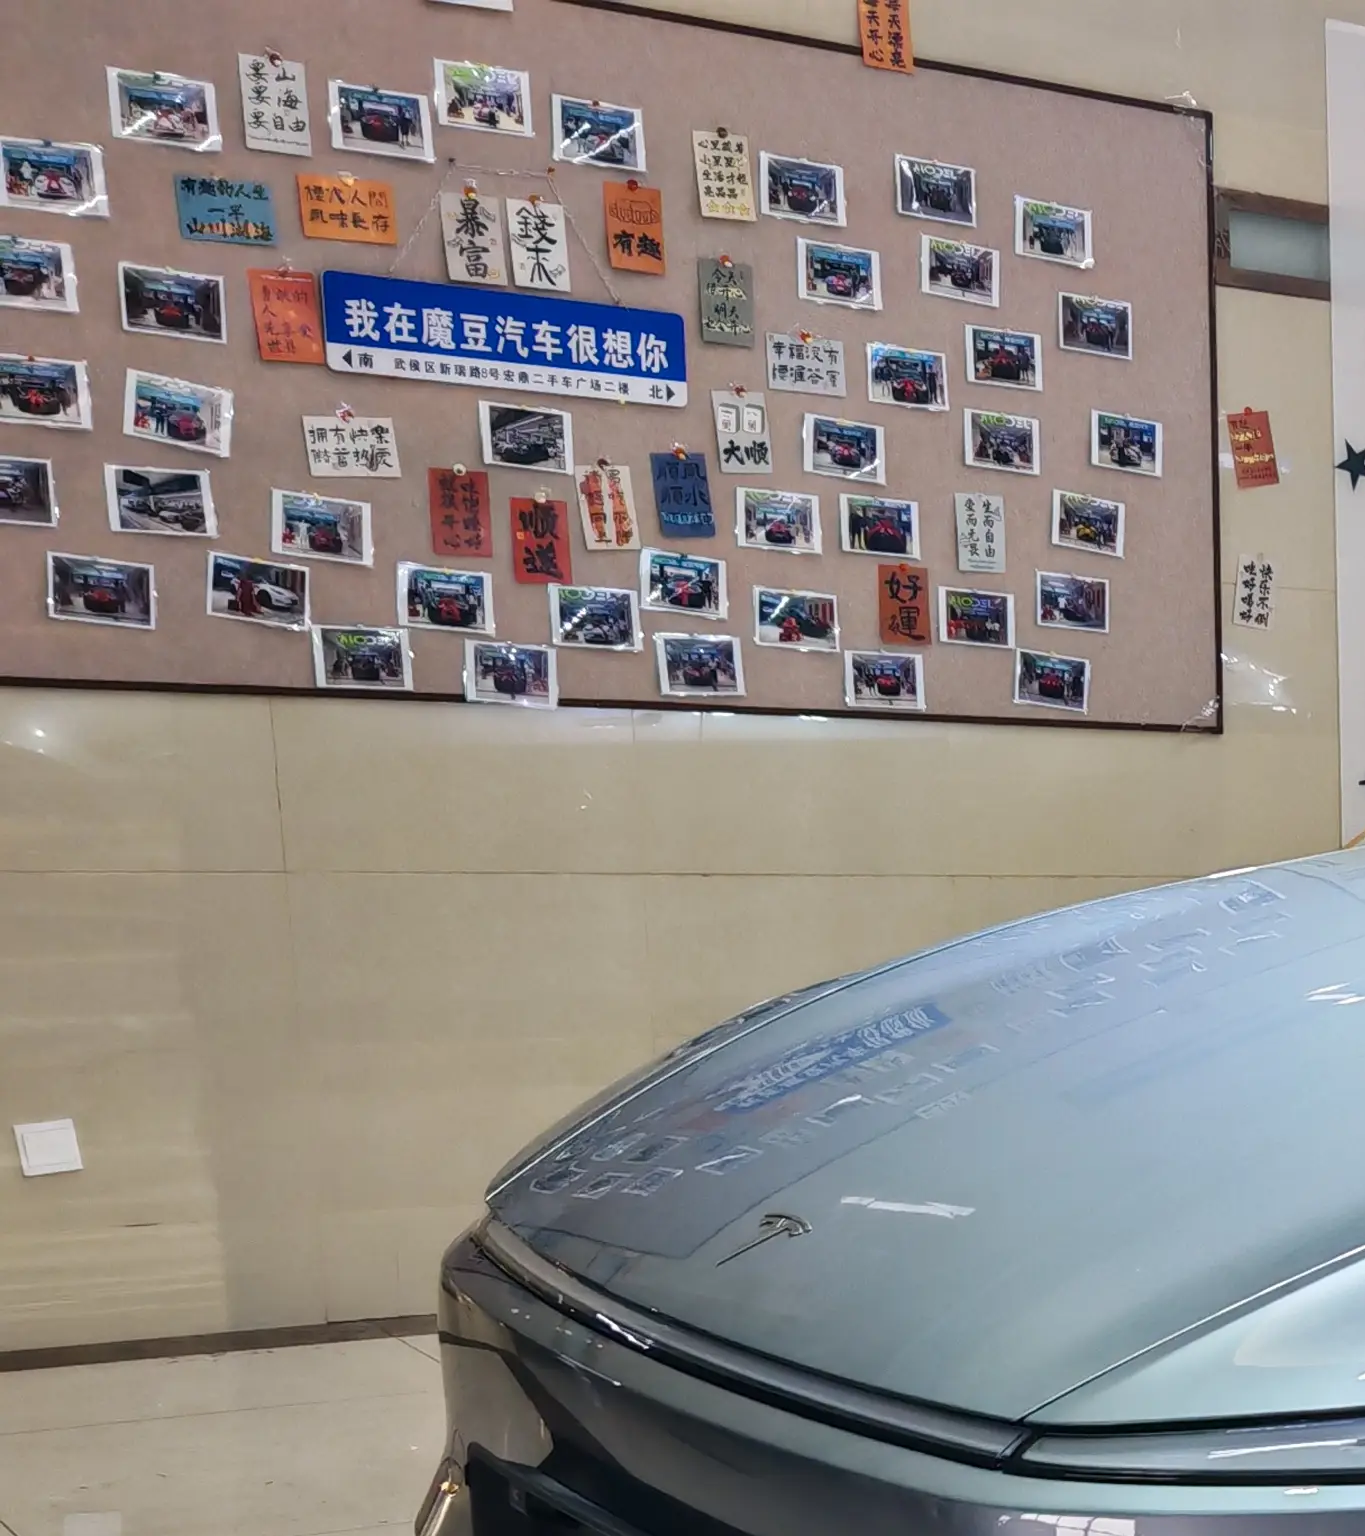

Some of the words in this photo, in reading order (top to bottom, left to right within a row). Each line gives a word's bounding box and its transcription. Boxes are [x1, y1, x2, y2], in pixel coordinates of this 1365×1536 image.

[344, 298, 669, 374] 我在魔豆汽车很想你
[358, 352, 374, 369] 南
[649, 384, 664, 400] 北
